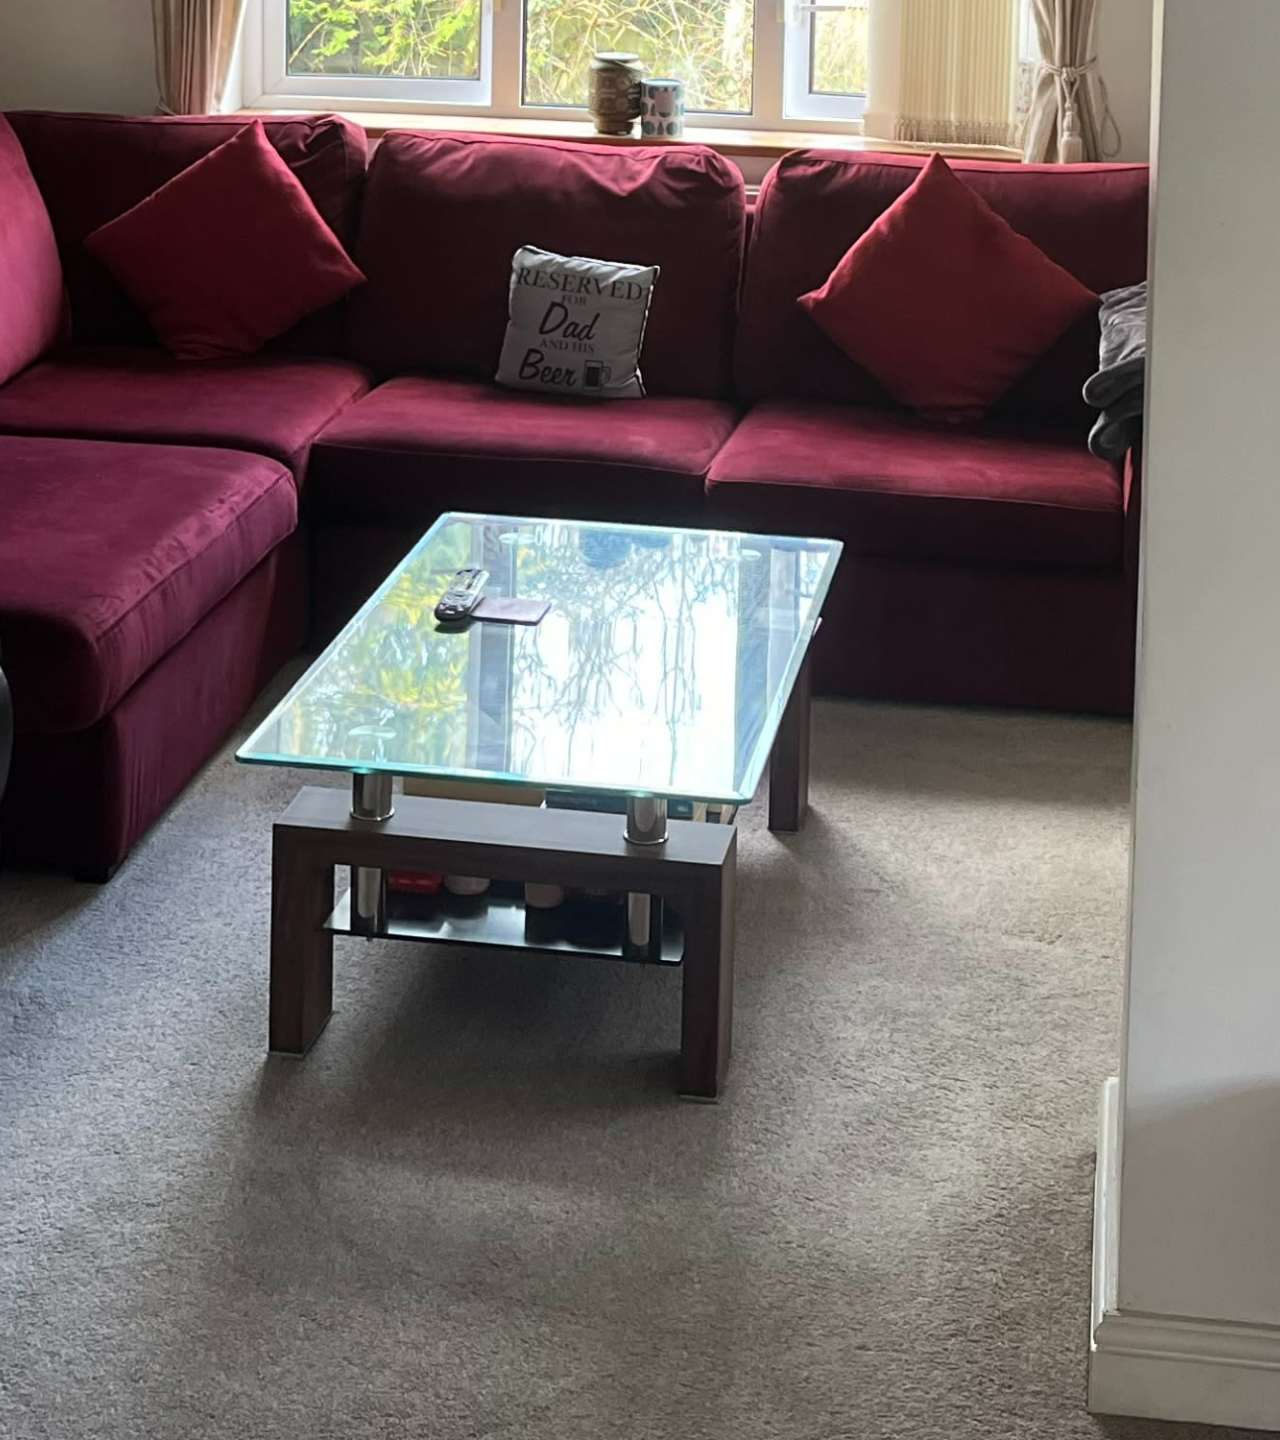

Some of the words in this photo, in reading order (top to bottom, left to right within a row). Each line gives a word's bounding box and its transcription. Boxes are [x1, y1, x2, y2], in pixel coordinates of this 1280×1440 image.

[516, 266, 643, 301] RESERVED
[538, 300, 601, 341] Dad
[518, 347, 577, 387] Beer
